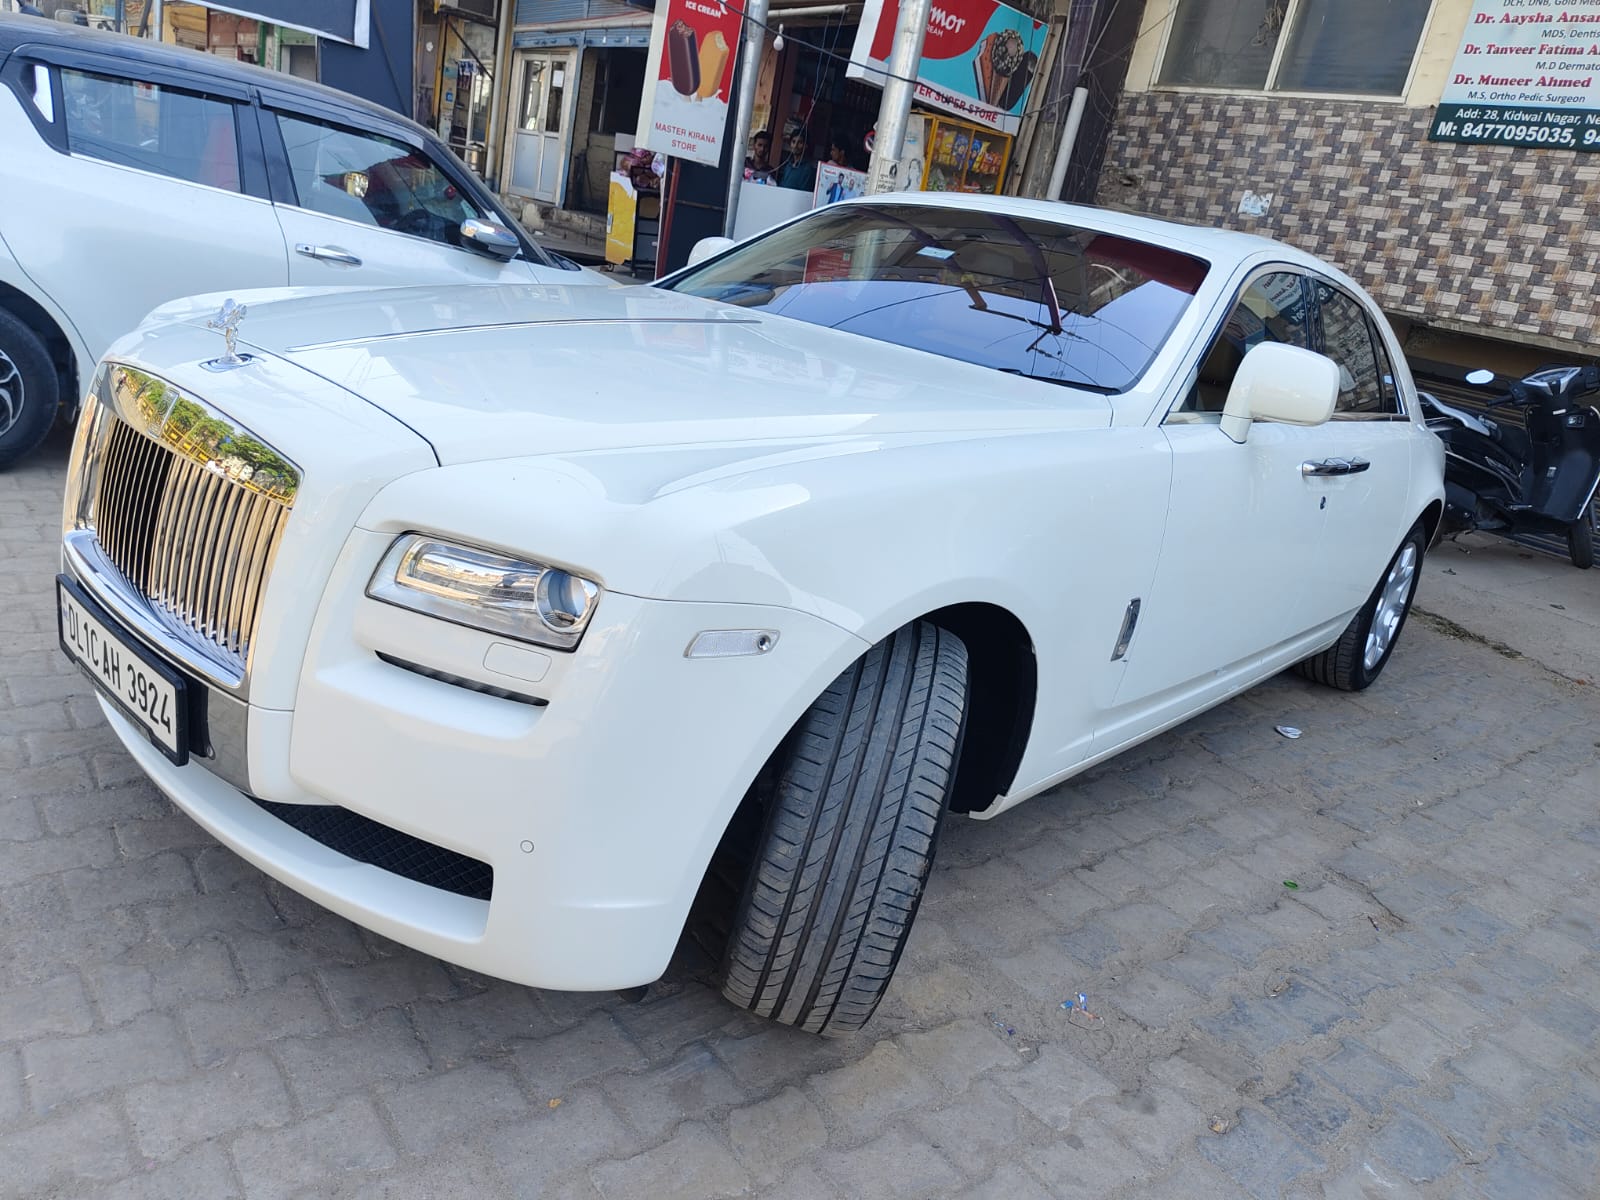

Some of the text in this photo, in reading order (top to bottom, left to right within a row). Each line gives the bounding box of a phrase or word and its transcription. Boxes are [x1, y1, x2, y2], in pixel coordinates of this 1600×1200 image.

[685, 1, 722, 19] ICE CREAM
[930, 6, 966, 34] mor
[1474, 13, 1496, 24] Dr.
[1499, 12, 1554, 26] Aaysha
[926, 24, 944, 38] REAM
[1541, 29, 1567, 39] MDS,
[1463, 44, 1482, 55] Dr.
[1486, 44, 1536, 55] Tanveer
[1537, 43, 1585, 55] Fatima
[1535, 61, 1557, 70] M.D
[1453, 74, 1593, 88] Dr. Muneer Ahmed
[1467, 91, 1586, 104] M.S, Ortho Pedic Surgeon
[934, 90, 967, 112] SUPER
[968, 103, 999, 123] STORE
[1455, 108, 1482, 119] Add:
[1483, 109, 1500, 122] 28,
[1503, 110, 1543, 122] Kidwai
[1543, 112, 1582, 126] Nagar,
[655, 122, 717, 145] MASTER KIRANA
[1436, 121, 1458, 137] M:
[1461, 122, 1577, 148] 8477095035,
[671, 139, 697, 152] STORE
[68, 602, 171, 734] DL1C AH 3924
